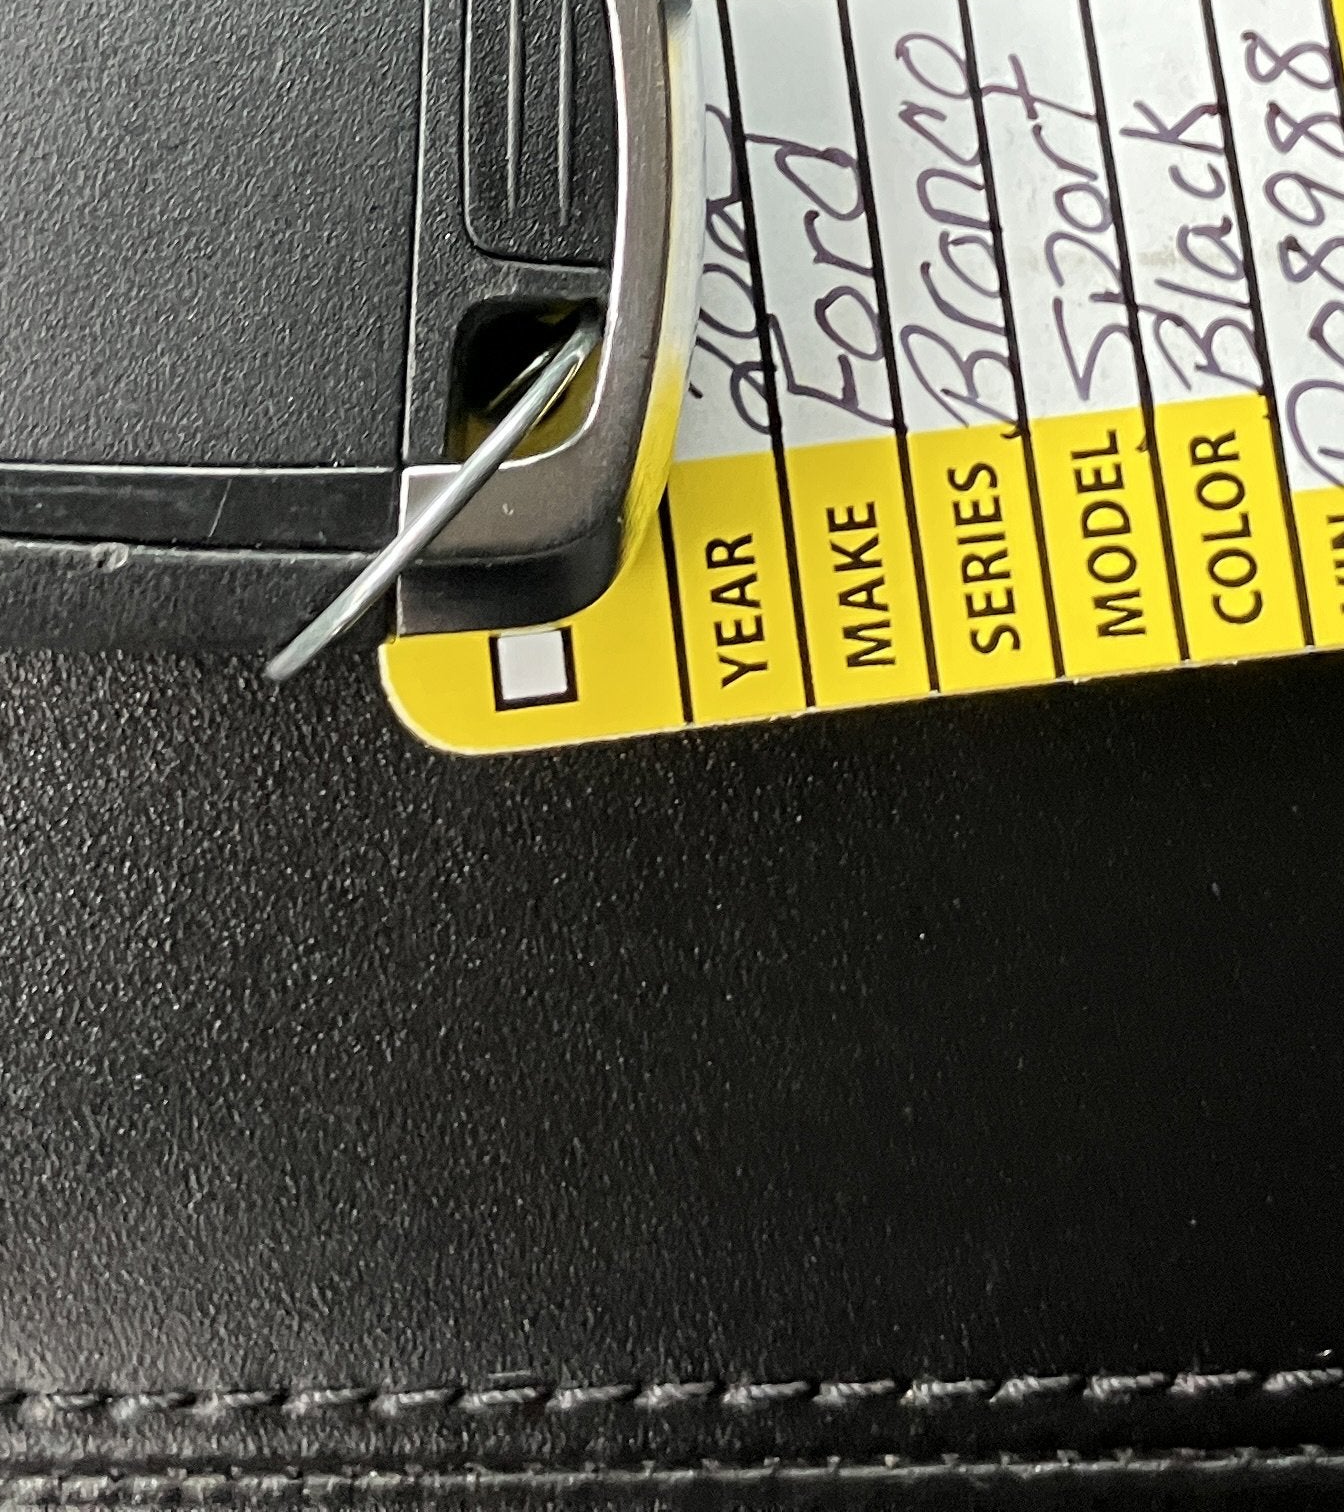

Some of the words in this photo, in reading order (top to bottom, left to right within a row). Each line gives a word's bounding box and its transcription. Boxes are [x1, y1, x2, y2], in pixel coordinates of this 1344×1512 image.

[744, 132, 906, 431] Ford
[896, 33, 1028, 439] Bronco
[980, 54, 1182, 400] Sport
[1120, 100, 1270, 396] Black
[705, 531, 768, 690] YEAR
[826, 499, 897, 671] MAKE
[947, 461, 1022, 656] SERIES
[1070, 428, 1148, 639] MODEL
[1189, 428, 1264, 626] COLOR
